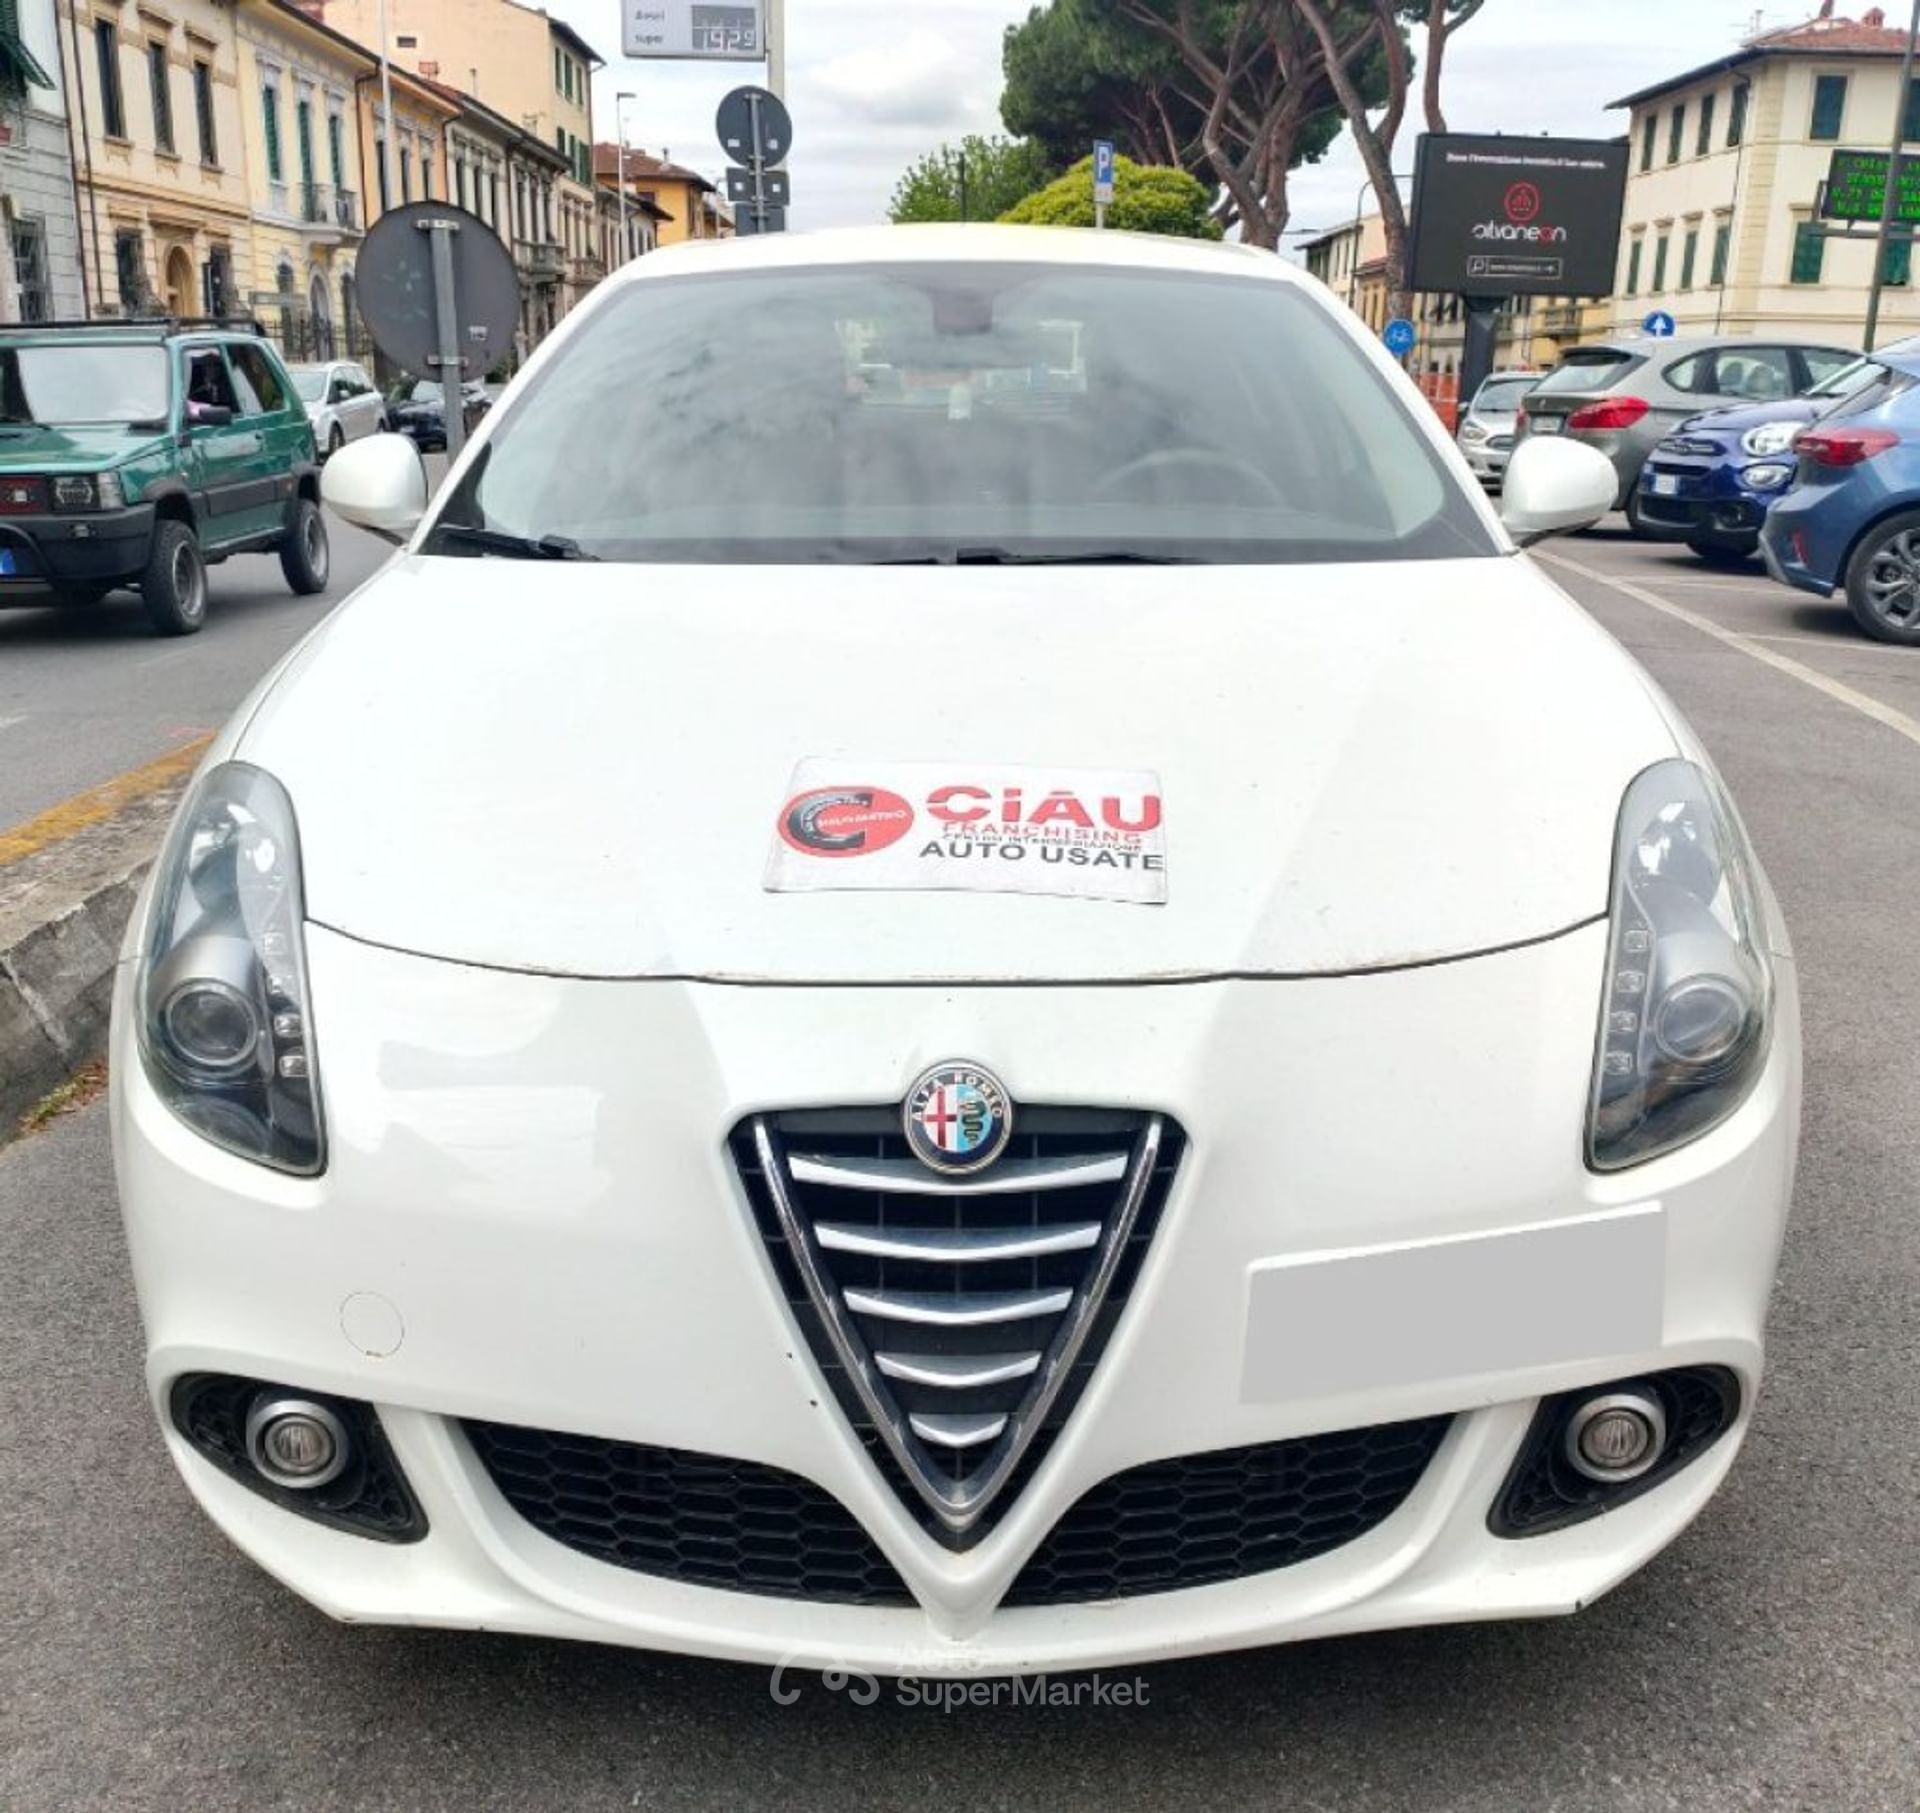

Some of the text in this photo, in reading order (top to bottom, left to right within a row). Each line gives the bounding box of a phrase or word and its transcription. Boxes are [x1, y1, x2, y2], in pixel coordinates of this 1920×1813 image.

[943, 822, 1142, 845] FRANCHISING
[919, 840, 1165, 871] AUTO USATE
